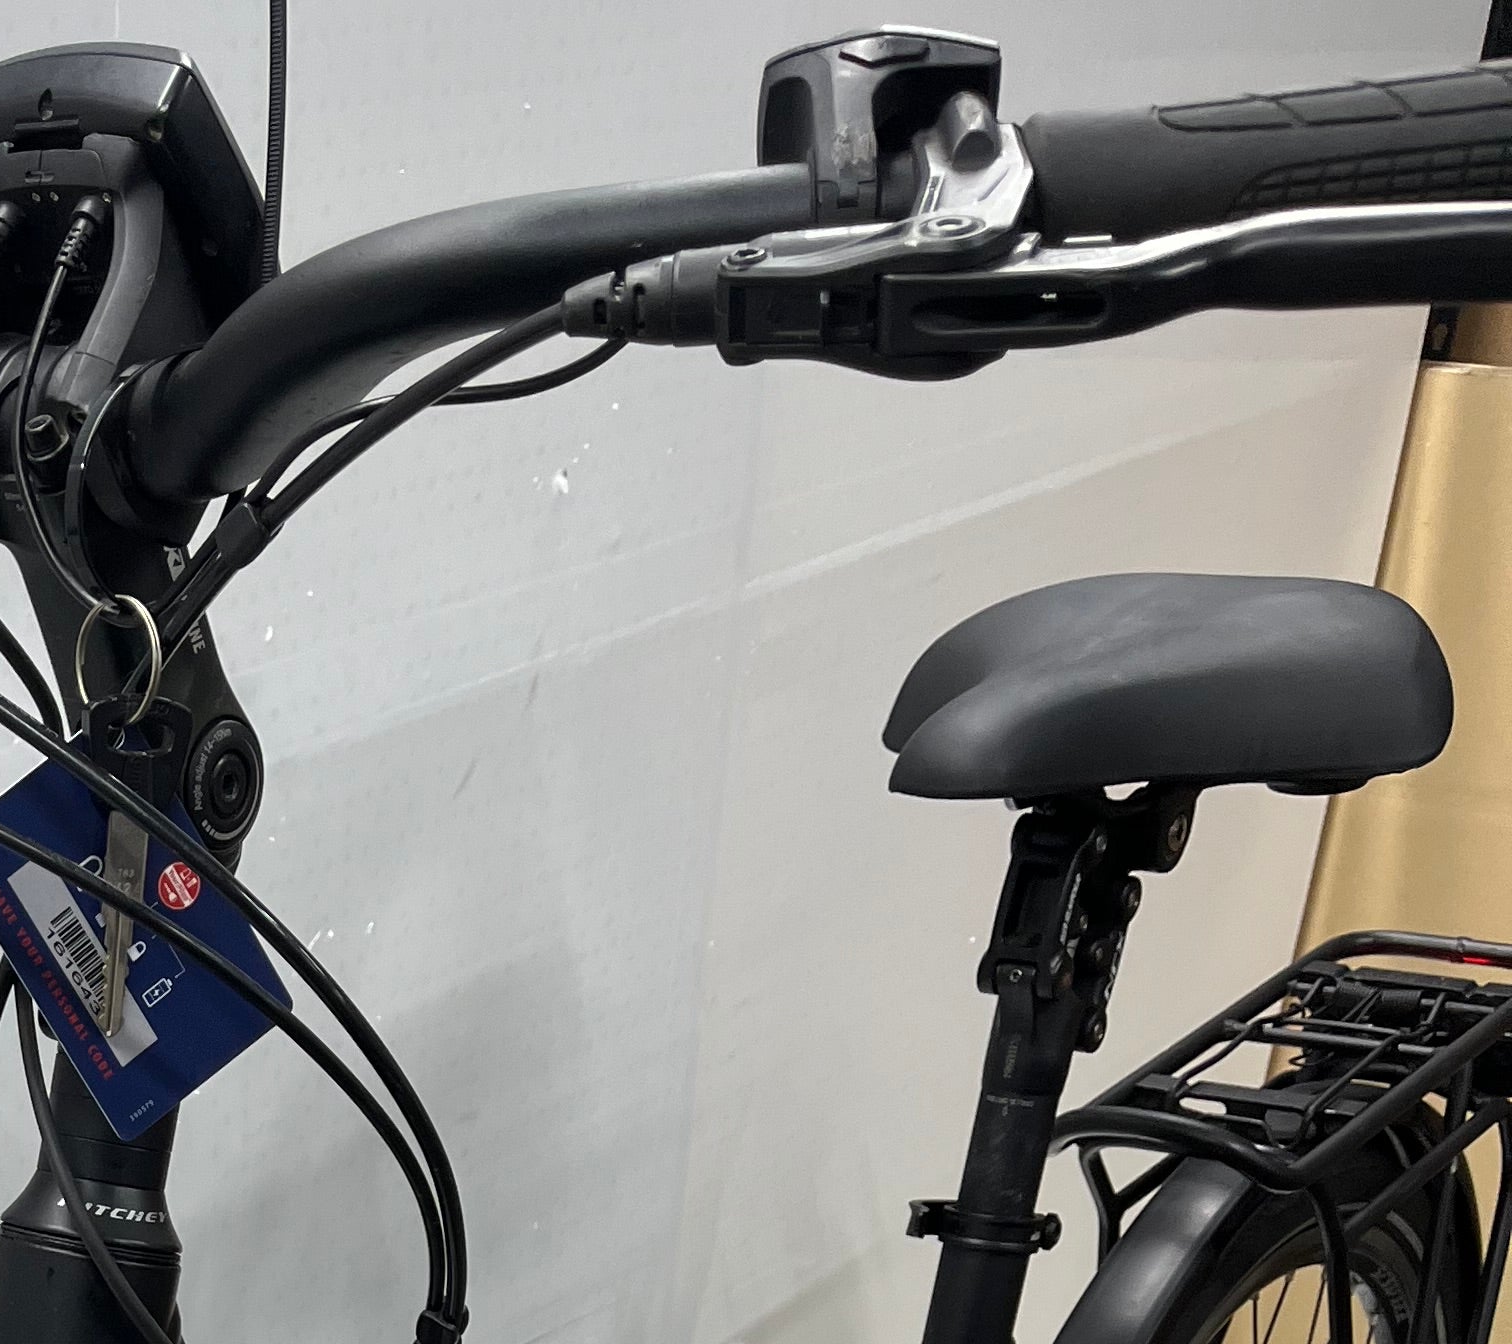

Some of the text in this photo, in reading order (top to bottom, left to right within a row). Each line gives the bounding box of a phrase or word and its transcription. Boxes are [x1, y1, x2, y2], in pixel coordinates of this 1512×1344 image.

[15, 927, 44, 967] YOUR
[42, 968, 89, 1042] PERSONAL
[87, 1043, 114, 1082] CODE
